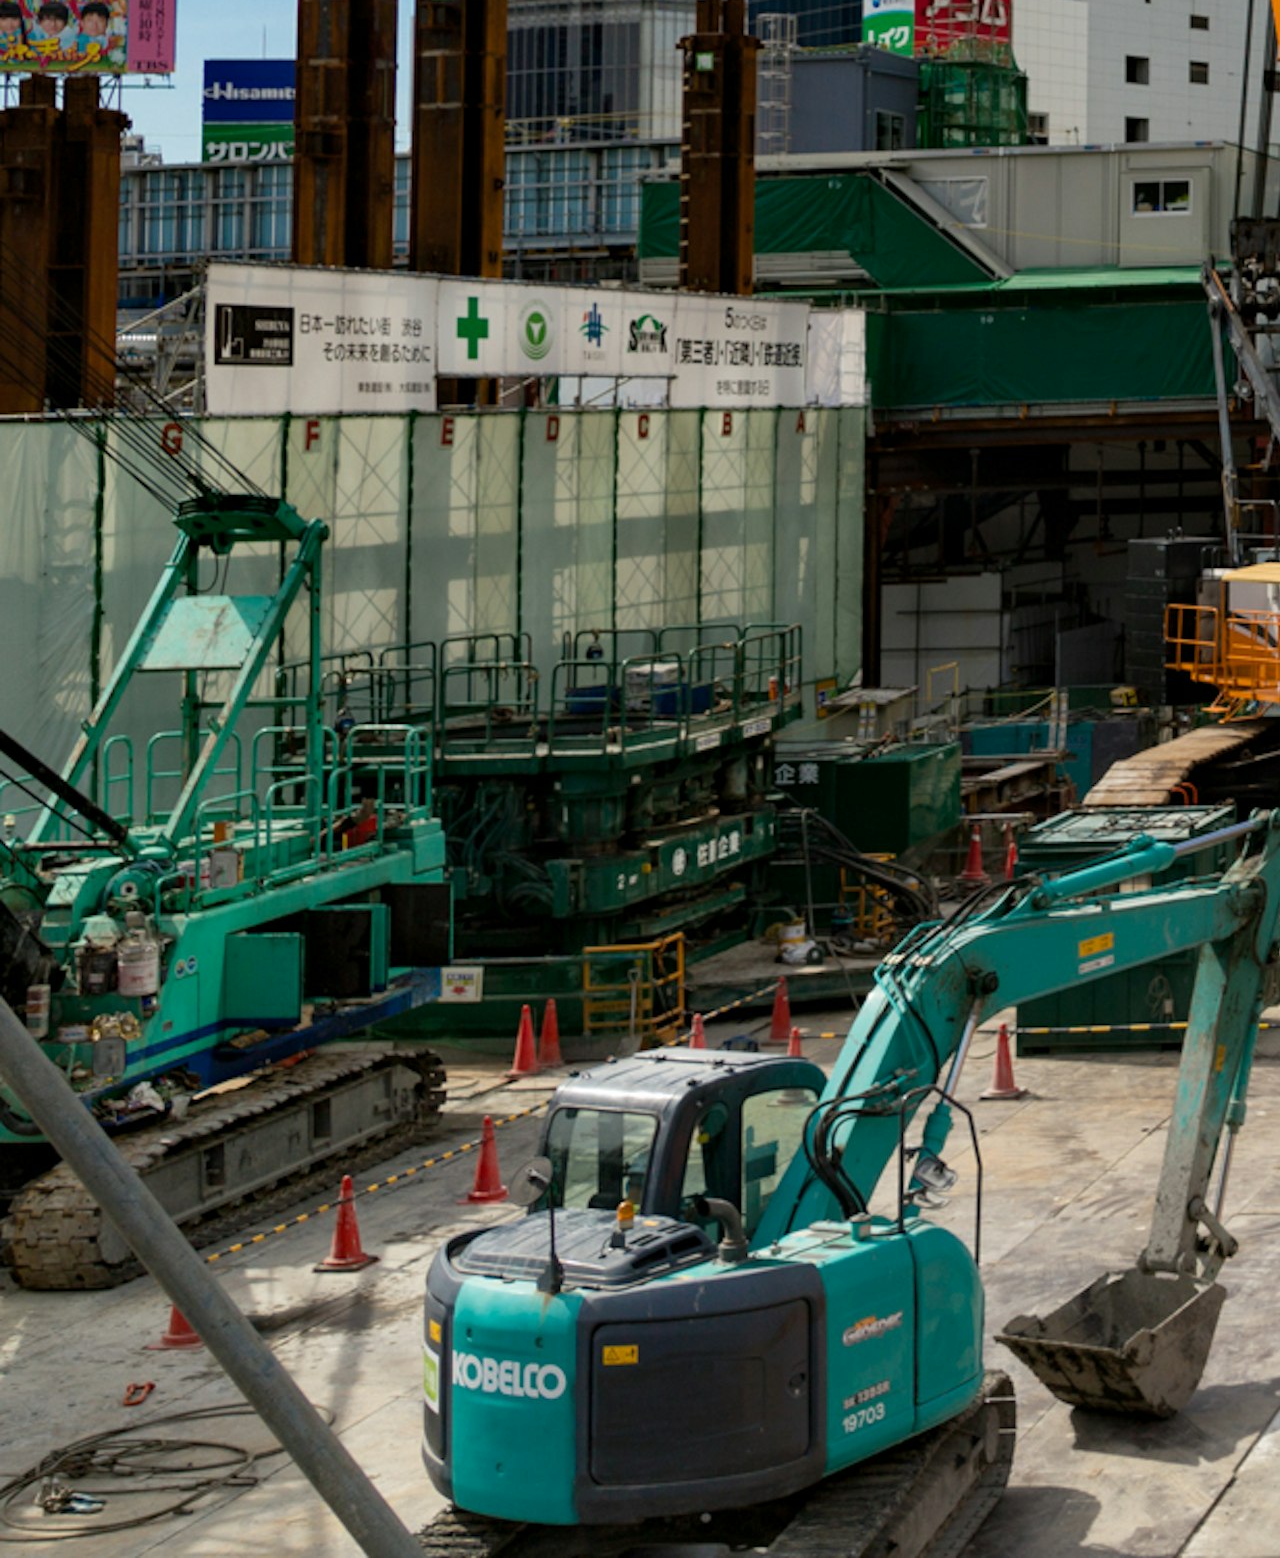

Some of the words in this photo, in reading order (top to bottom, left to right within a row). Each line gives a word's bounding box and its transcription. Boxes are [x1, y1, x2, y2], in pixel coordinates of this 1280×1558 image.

[133, 60, 168, 70] TBS
[160, 422, 183, 455] G
[304, 419, 319, 451] F
[441, 417, 454, 445] E
[546, 415, 560, 441] D
[637, 413, 650, 439] C
[721, 412, 733, 437] B
[452, 1349, 567, 1400] KOBELCO
[842, 1402, 886, 1434] 19703
